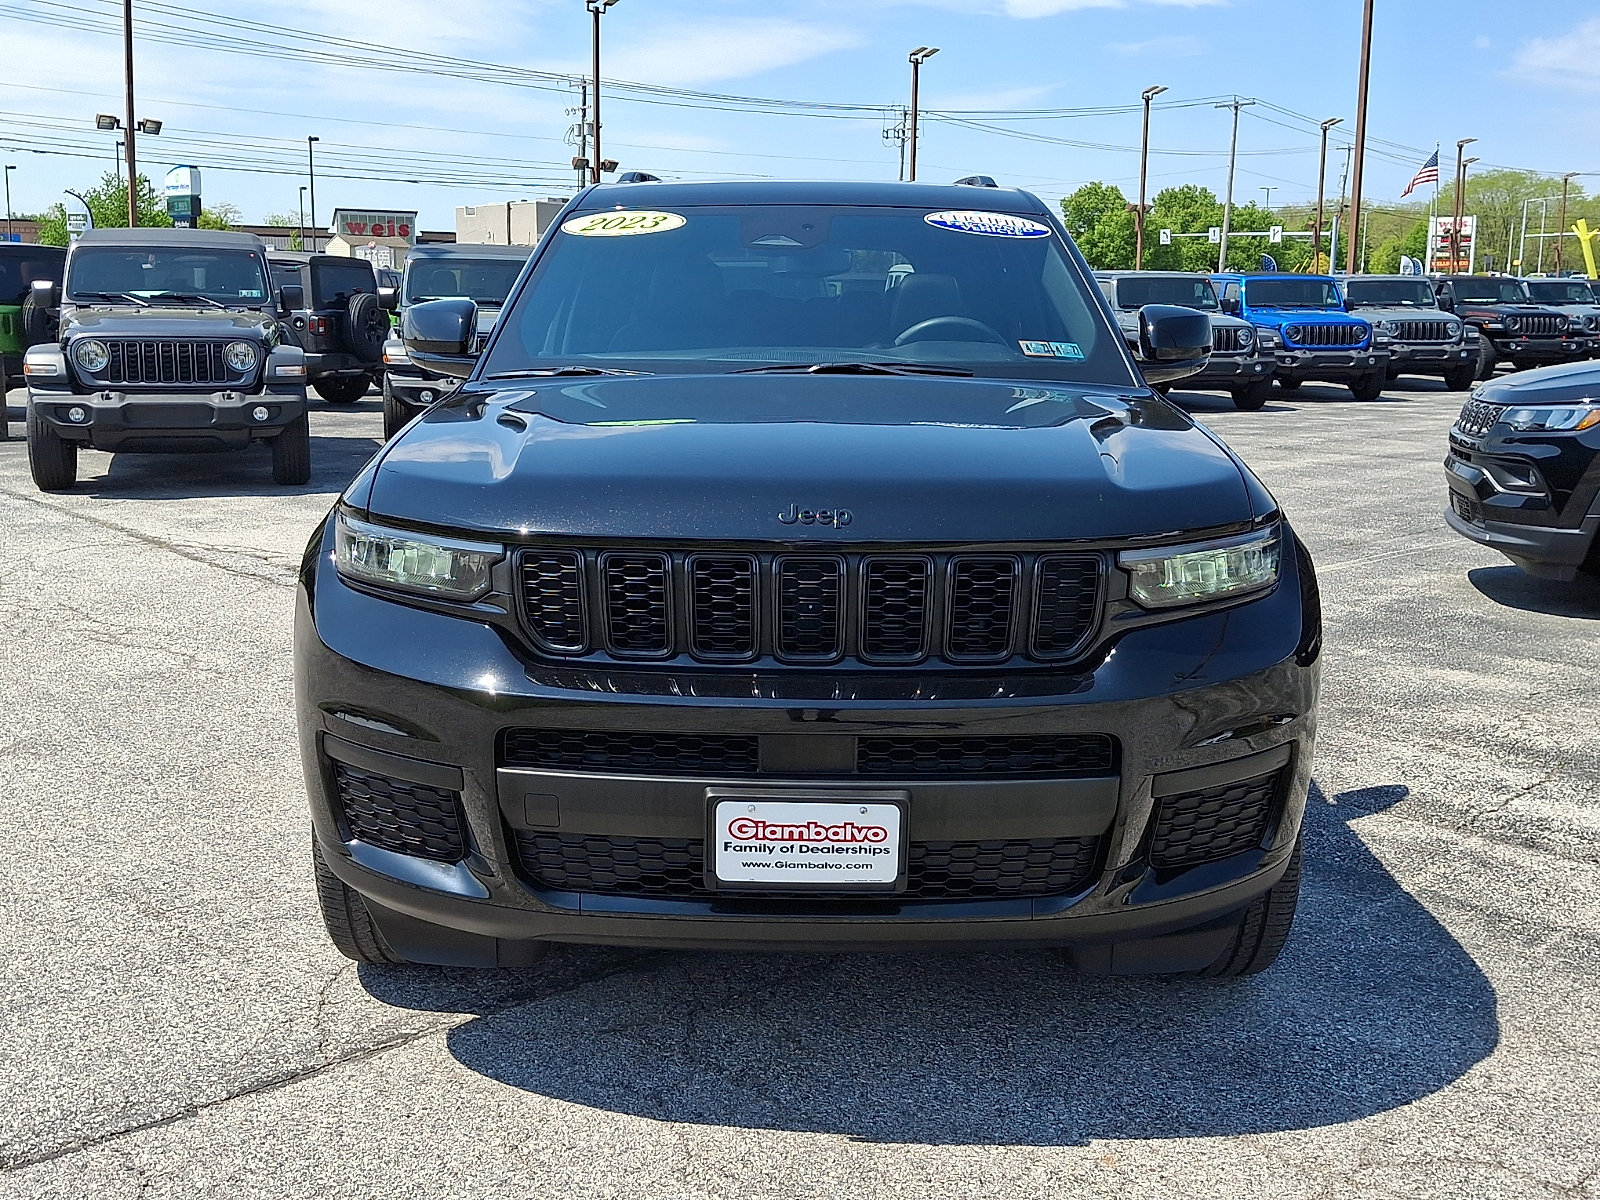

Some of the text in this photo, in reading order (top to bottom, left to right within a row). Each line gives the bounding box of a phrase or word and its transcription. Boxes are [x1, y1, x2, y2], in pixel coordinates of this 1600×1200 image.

[346, 219, 410, 237] weis
[580, 216, 667, 231] 2023
[777, 503, 853, 529] Jeep
[728, 817, 888, 843] Giambalvo
[723, 842, 891, 856] Family of Dealerships
[741, 861, 873, 870] www.Giambalvo.com
